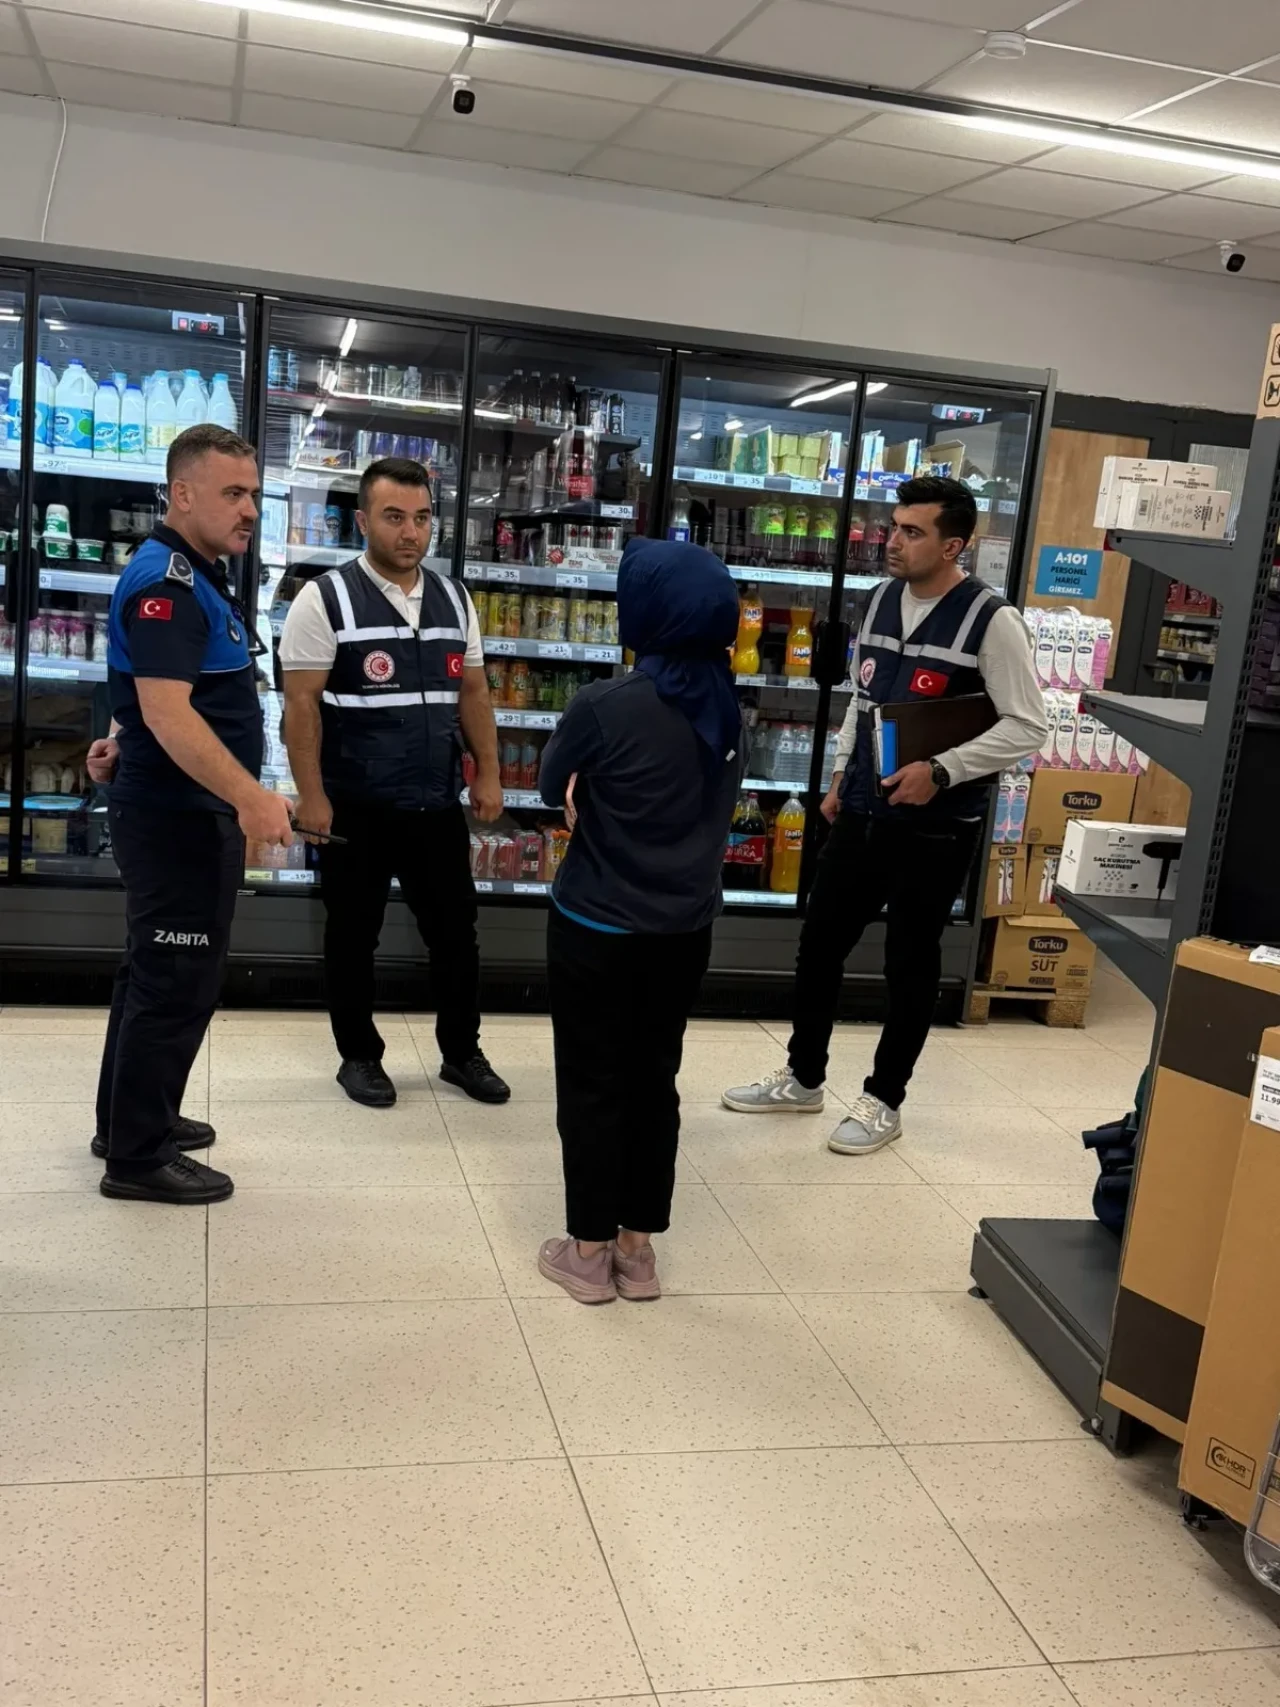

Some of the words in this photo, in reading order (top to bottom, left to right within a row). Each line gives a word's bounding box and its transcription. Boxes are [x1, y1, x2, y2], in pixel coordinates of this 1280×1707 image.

[1050, 566, 1088, 576] PERSONEL
[744, 608, 761, 616] FANT
[793, 646, 811, 655] FANT
[1067, 794, 1098, 807] Torku
[784, 829, 802, 838] FANT
[1108, 857, 1141, 865] KURUTMA
[153, 929, 209, 946] ZABITA
[1033, 939, 1064, 950] Torku
[1030, 959, 1058, 972] SÜT
